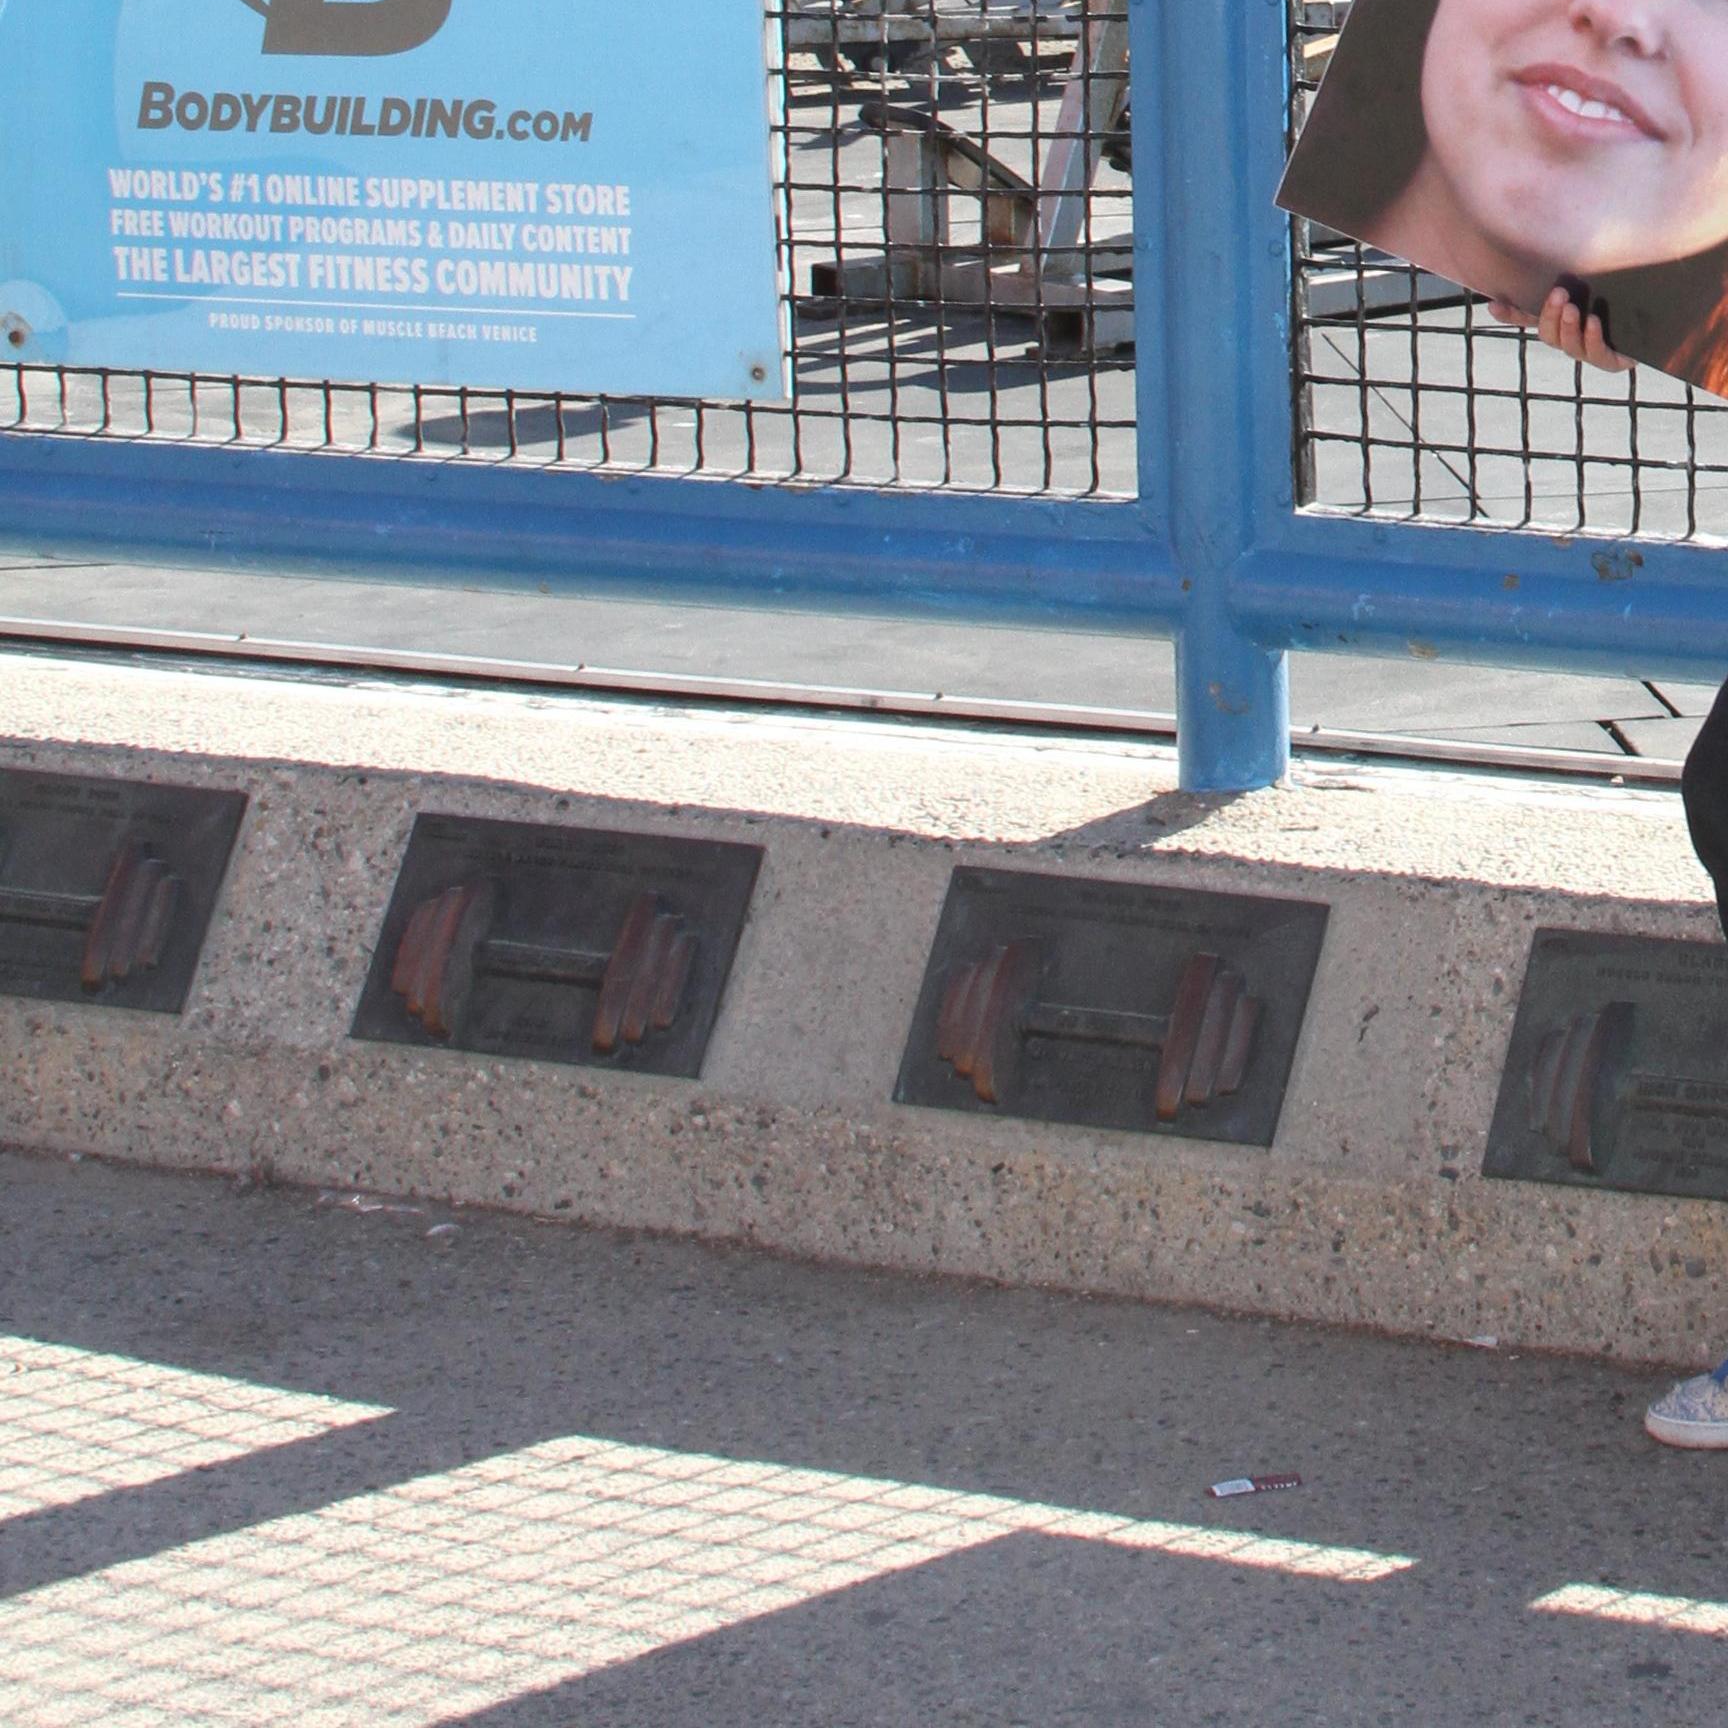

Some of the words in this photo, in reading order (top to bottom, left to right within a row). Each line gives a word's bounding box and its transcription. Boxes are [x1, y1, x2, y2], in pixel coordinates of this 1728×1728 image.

[109, 168, 224, 203] WORLD'S
[264, 174, 361, 207] ONLINE
[365, 177, 539, 214] SUPPLEMENT
[545, 183, 632, 217] STORE
[110, 208, 166, 238] FREE
[168, 210, 284, 242] WORKOUT
[288, 215, 422, 248] PROGRAMS
[427, 220, 445, 249] &
[448, 221, 517, 251] DAILY
[521, 223, 633, 256] CONTENT
[112, 246, 169, 282] THE
[174, 248, 302, 289] LARGEST
[307, 254, 431, 295] FITNESS
[435, 258, 634, 302] COMMUNITY
[208, 313, 261, 330] PROUD
[264, 315, 335, 334] SPONSOR
[339, 318, 358, 334] OF
[362, 319, 424, 339] MUSCLE
[427, 322, 477, 341] BEACH
[481, 324, 538, 344] VENICE
